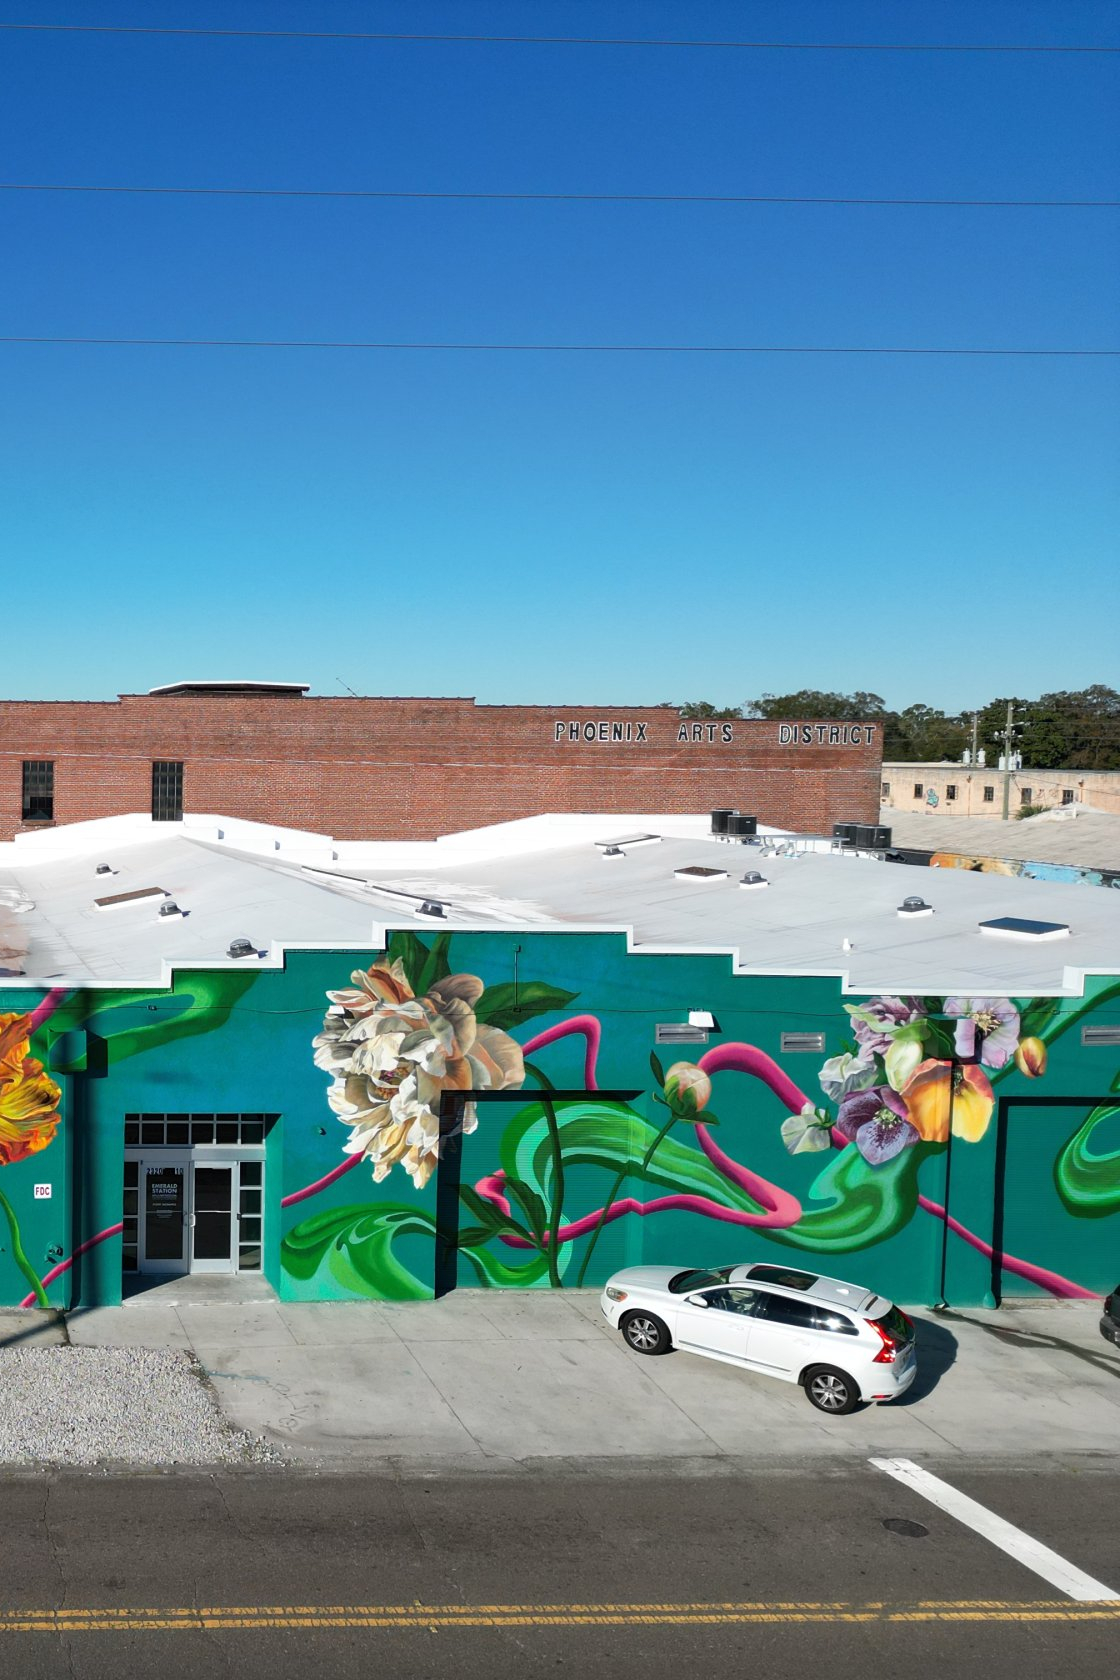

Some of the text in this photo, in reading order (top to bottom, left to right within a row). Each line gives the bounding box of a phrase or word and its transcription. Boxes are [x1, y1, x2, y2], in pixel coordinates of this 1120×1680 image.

[554, 721, 876, 745] PHOENIX ARTS DISTRICT
[35, 1186, 50, 1196] FDC
